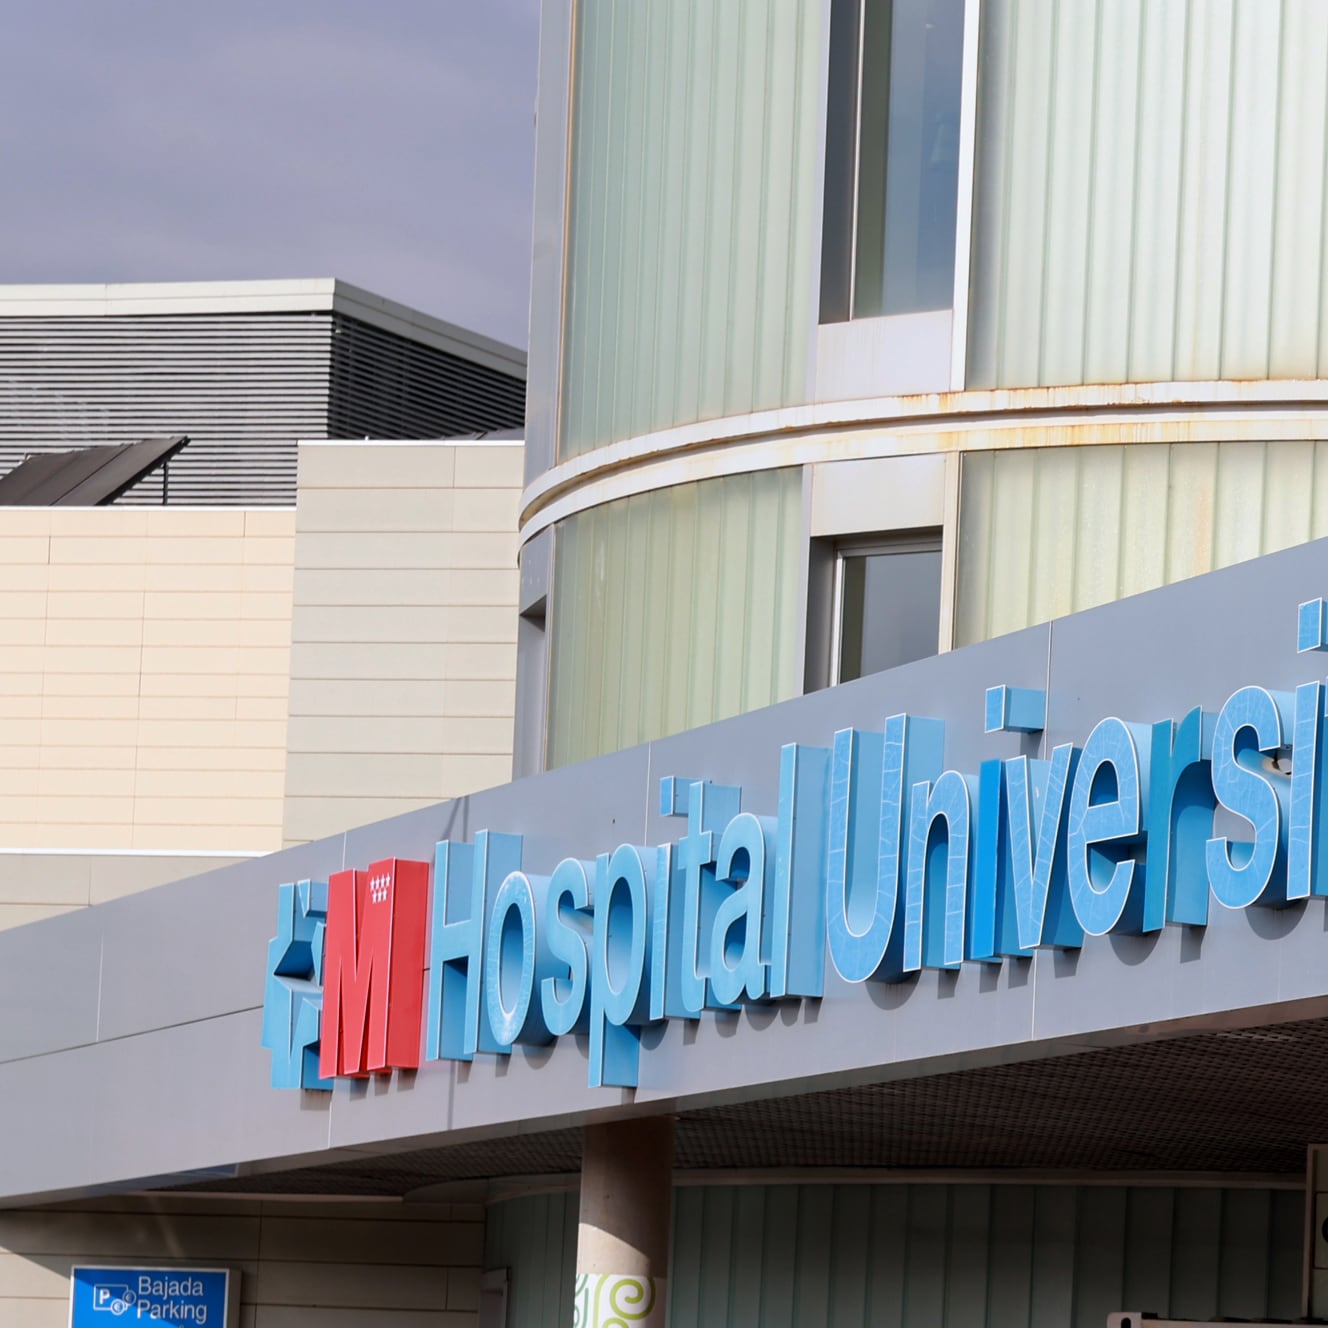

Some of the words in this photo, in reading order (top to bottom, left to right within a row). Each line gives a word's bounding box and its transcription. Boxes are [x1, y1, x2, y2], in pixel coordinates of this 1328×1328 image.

[425, 742, 828, 1087] Hospital
[138, 1276, 204, 1300] Bajada
[137, 1300, 208, 1325] Parking
